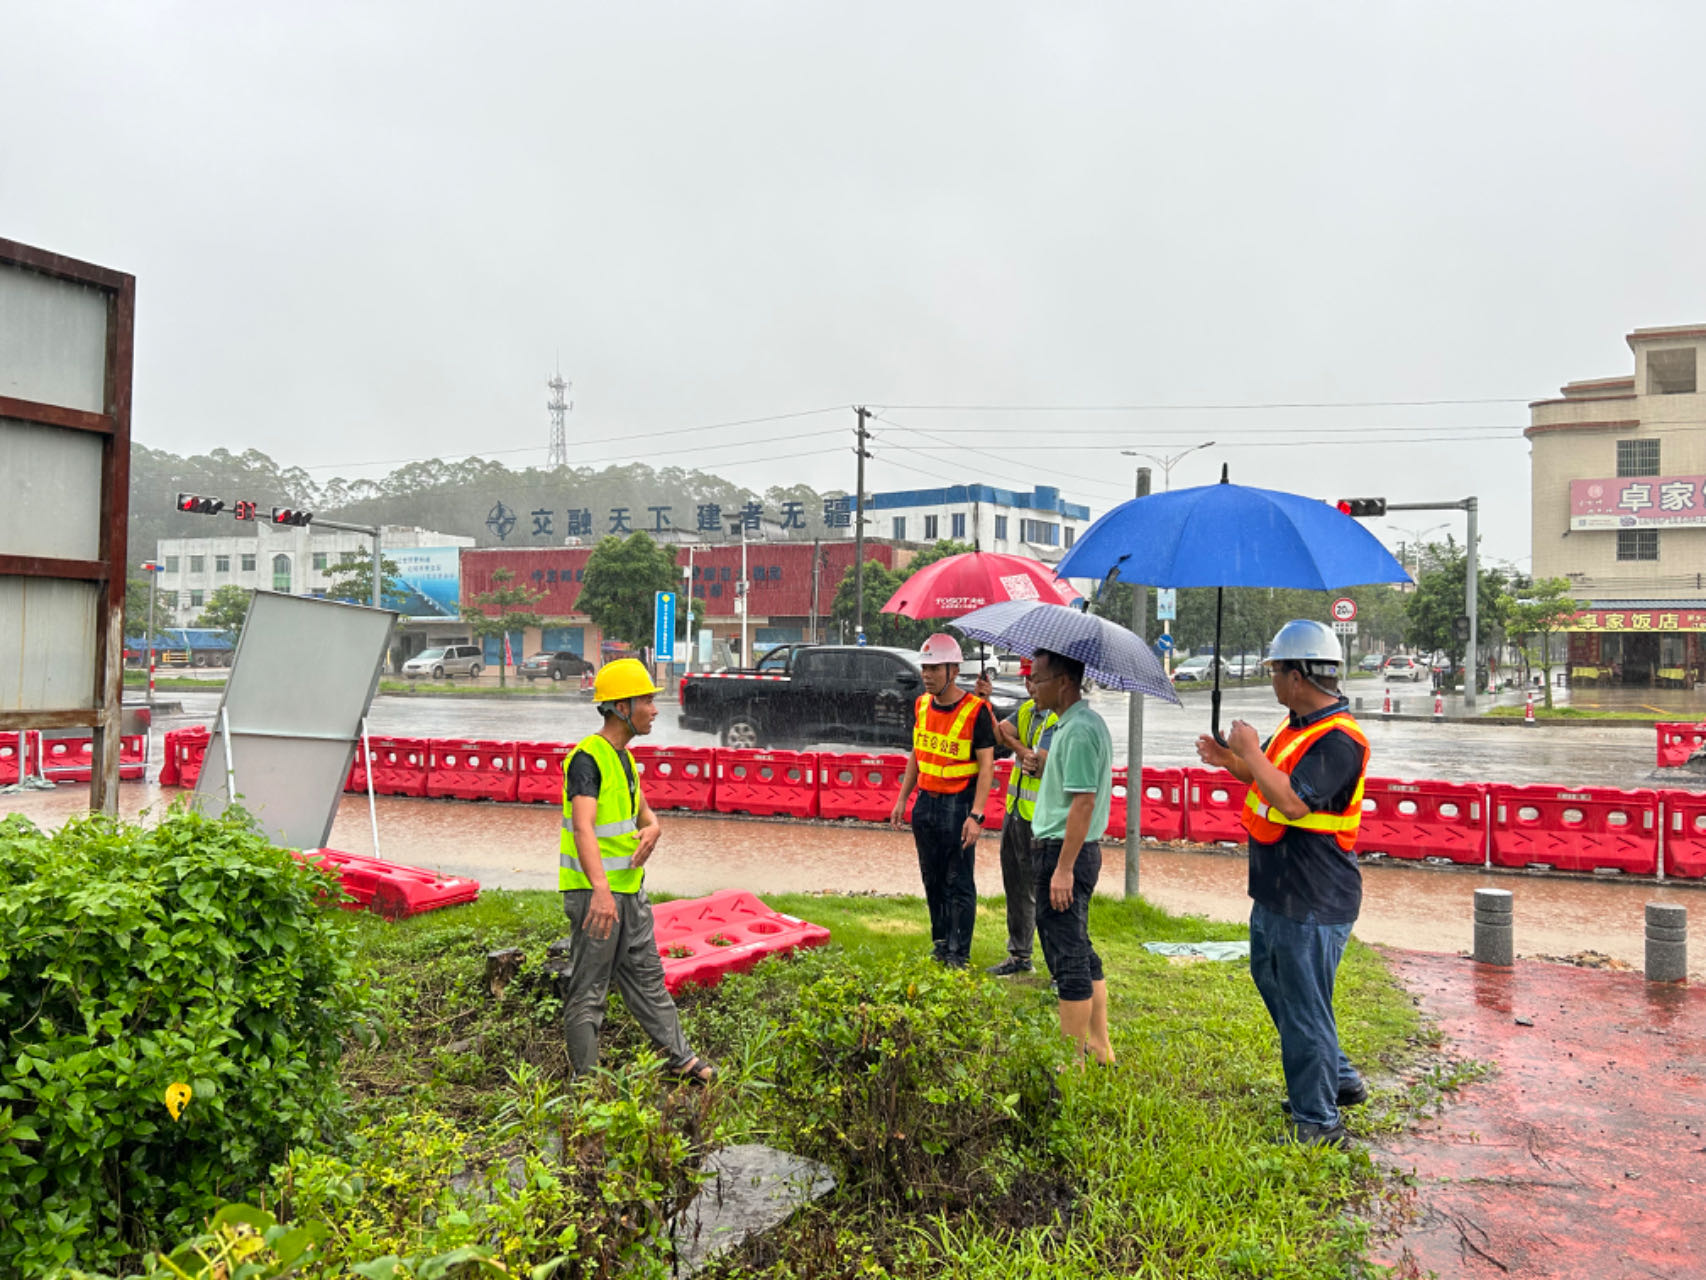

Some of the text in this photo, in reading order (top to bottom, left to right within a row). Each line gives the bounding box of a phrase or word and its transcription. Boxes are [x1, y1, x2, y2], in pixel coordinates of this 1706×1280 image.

[1618, 481, 1706, 513] 卓家
[1577, 613, 1679, 630] 卓家饭店
